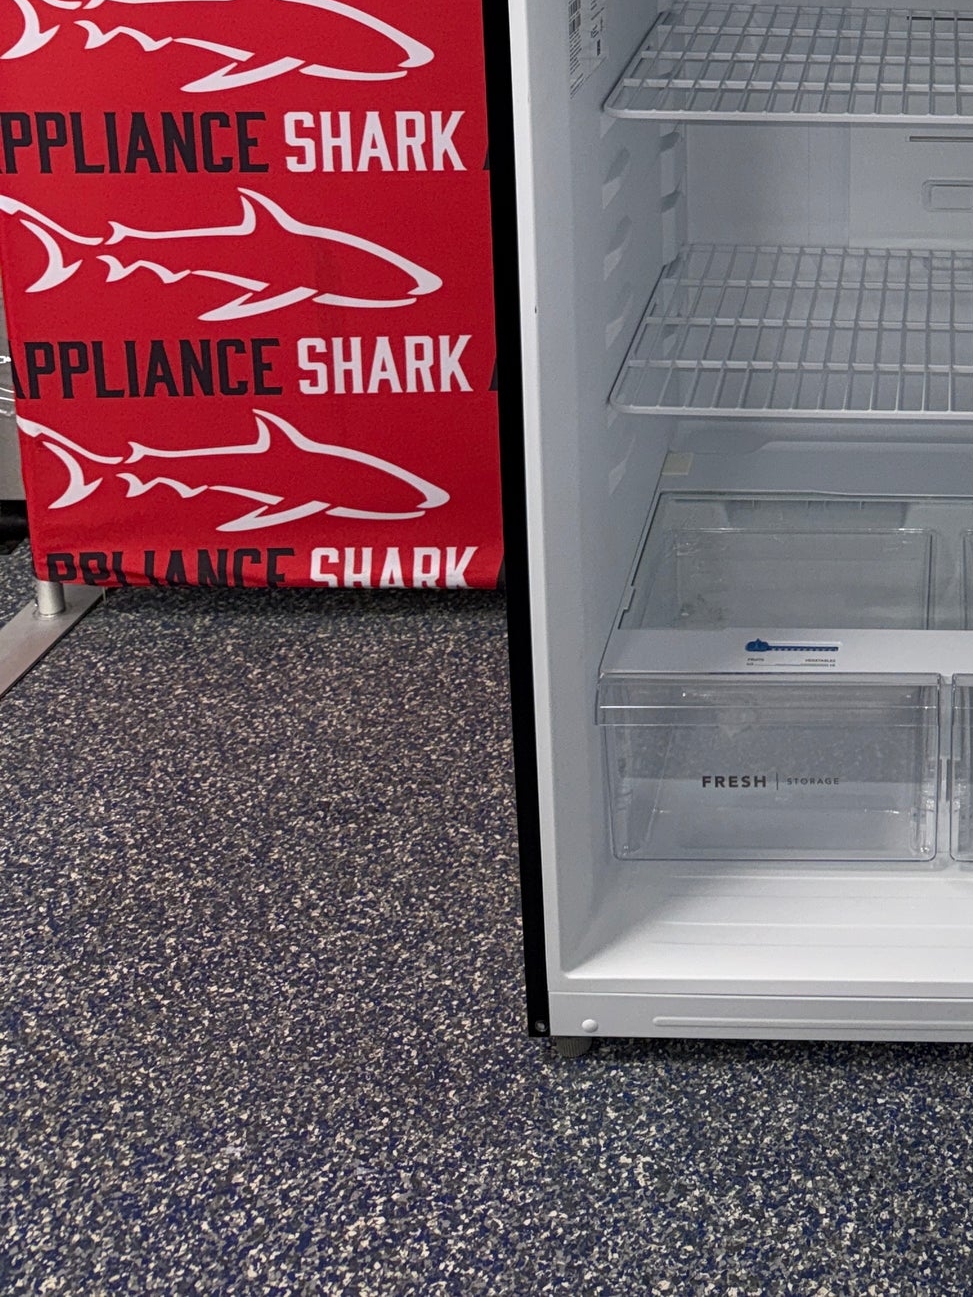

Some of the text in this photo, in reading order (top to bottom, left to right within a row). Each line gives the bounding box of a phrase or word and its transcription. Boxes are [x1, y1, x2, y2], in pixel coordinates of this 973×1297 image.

[283, 110, 467, 173] SHARK
[297, 334, 473, 395] SHARK
[310, 546, 478, 588] SHARK
[702, 775, 840, 788] FRESH STORAGE
